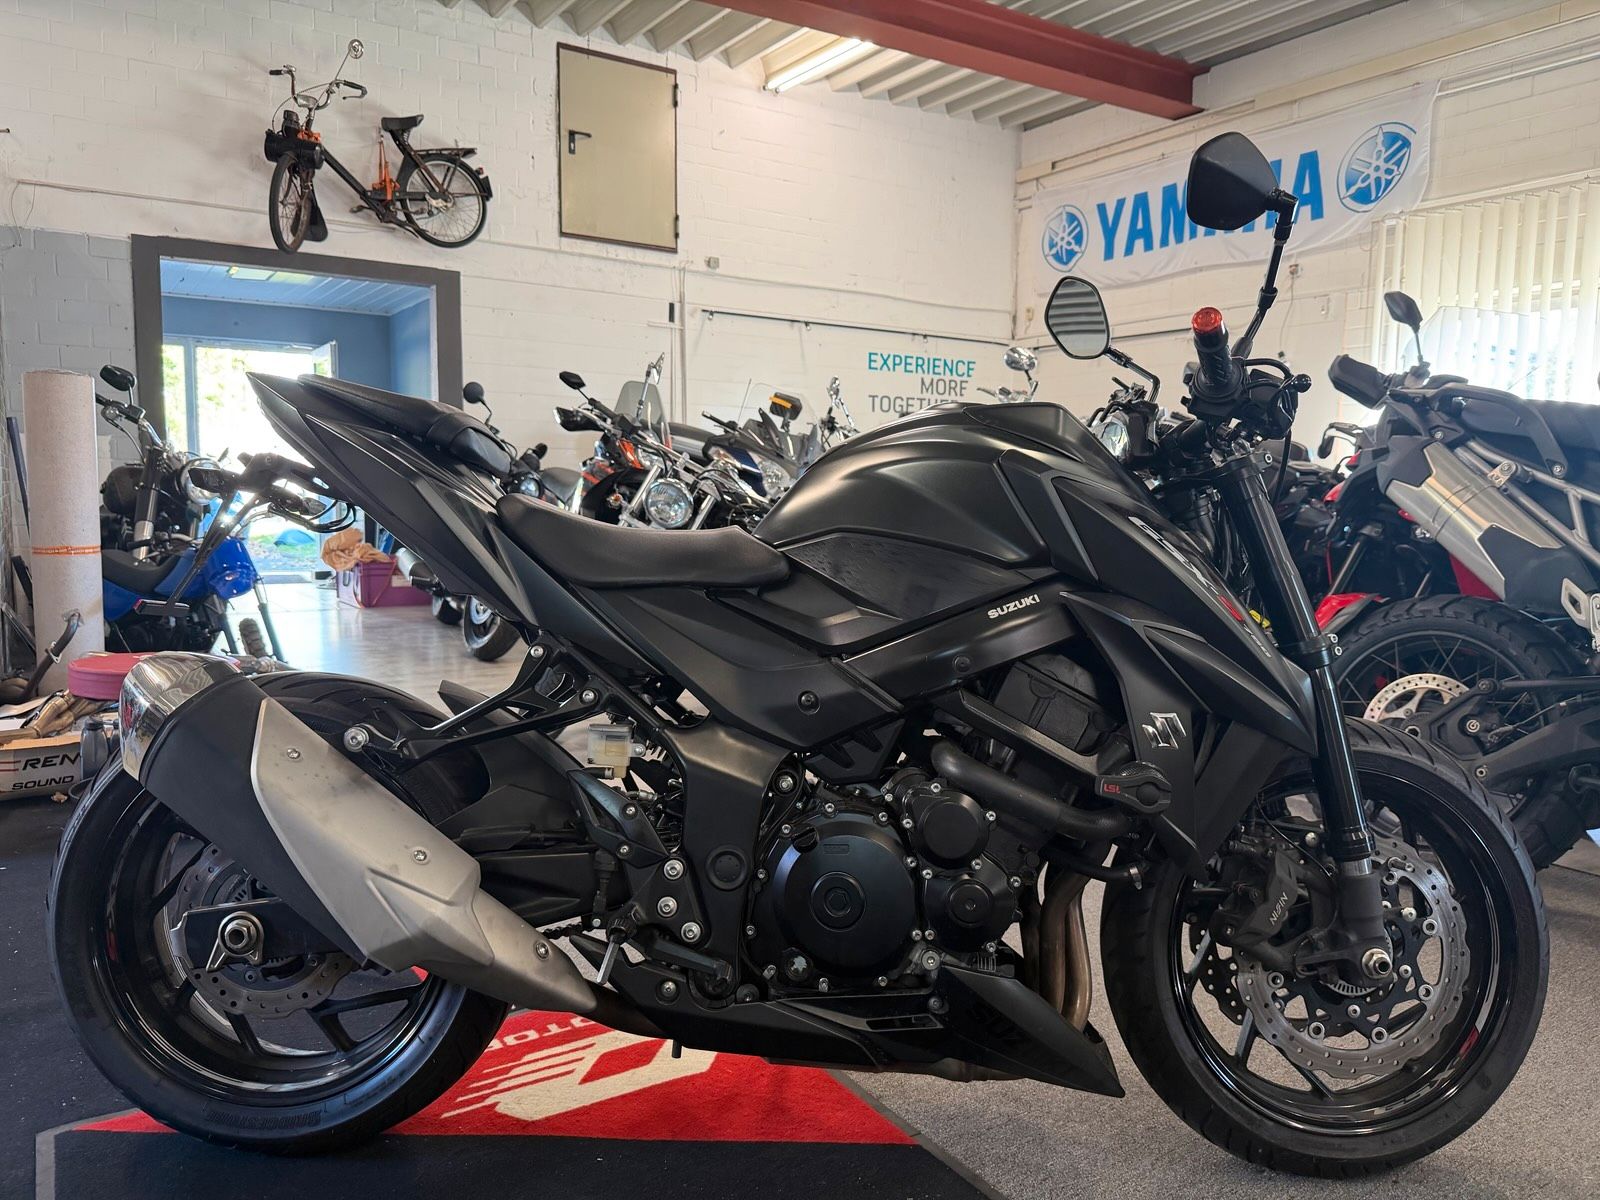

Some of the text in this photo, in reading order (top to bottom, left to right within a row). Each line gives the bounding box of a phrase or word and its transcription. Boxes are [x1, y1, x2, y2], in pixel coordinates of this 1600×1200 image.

[1097, 150, 1324, 261] YAMA
[868, 352, 976, 377] EXPERIENCE
[920, 378, 968, 397] MORE
[987, 594, 1040, 620] SUZUKI
[12, 775, 74, 790] SOUND
